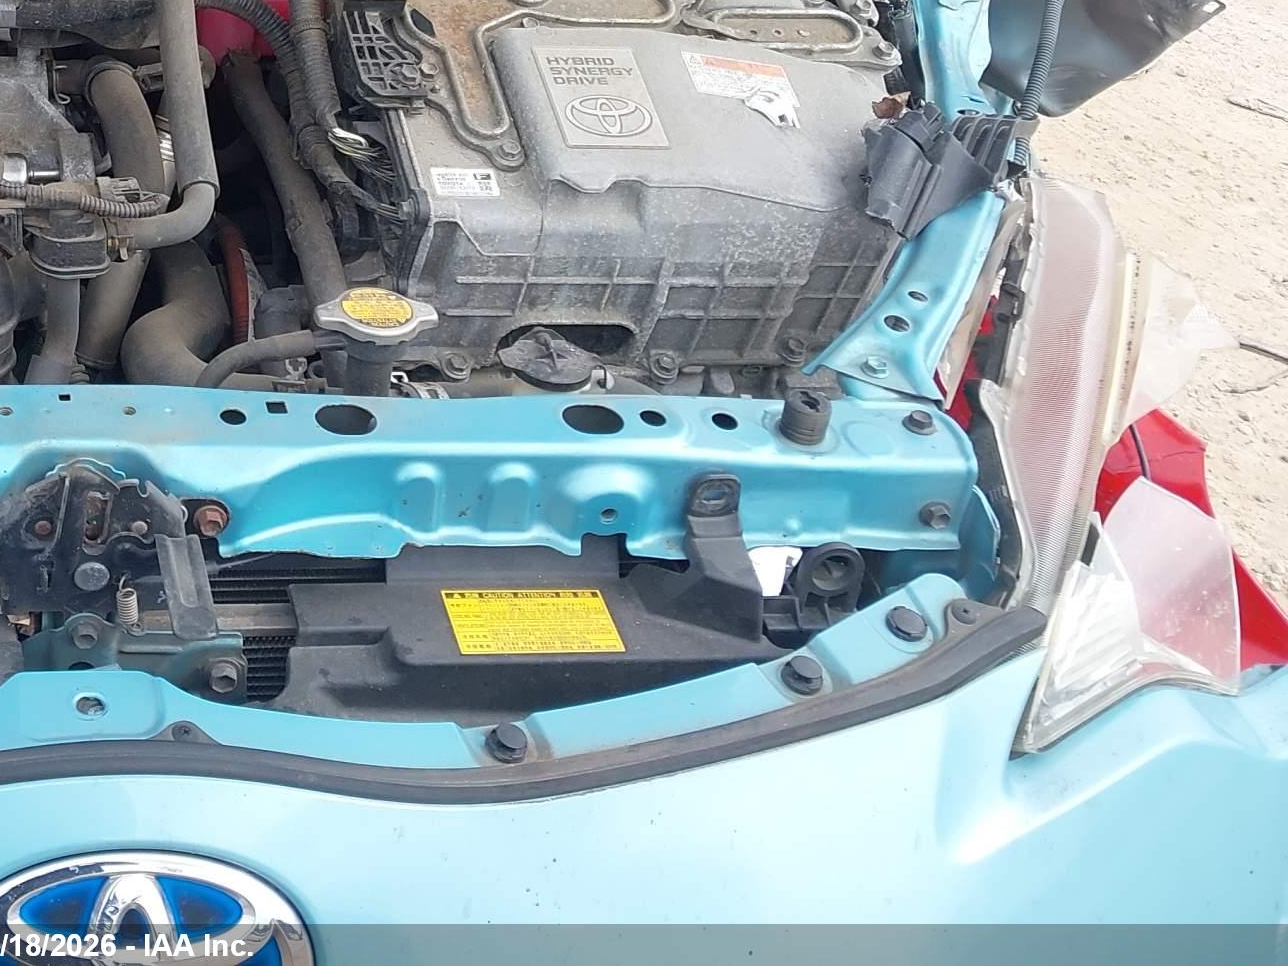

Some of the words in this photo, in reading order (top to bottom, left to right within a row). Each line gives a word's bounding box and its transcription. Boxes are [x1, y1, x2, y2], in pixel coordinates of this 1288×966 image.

[546, 57, 615, 66] HYBRID
[550, 66, 633, 76] SYNERGY
[553, 76, 609, 85] DRIVE
